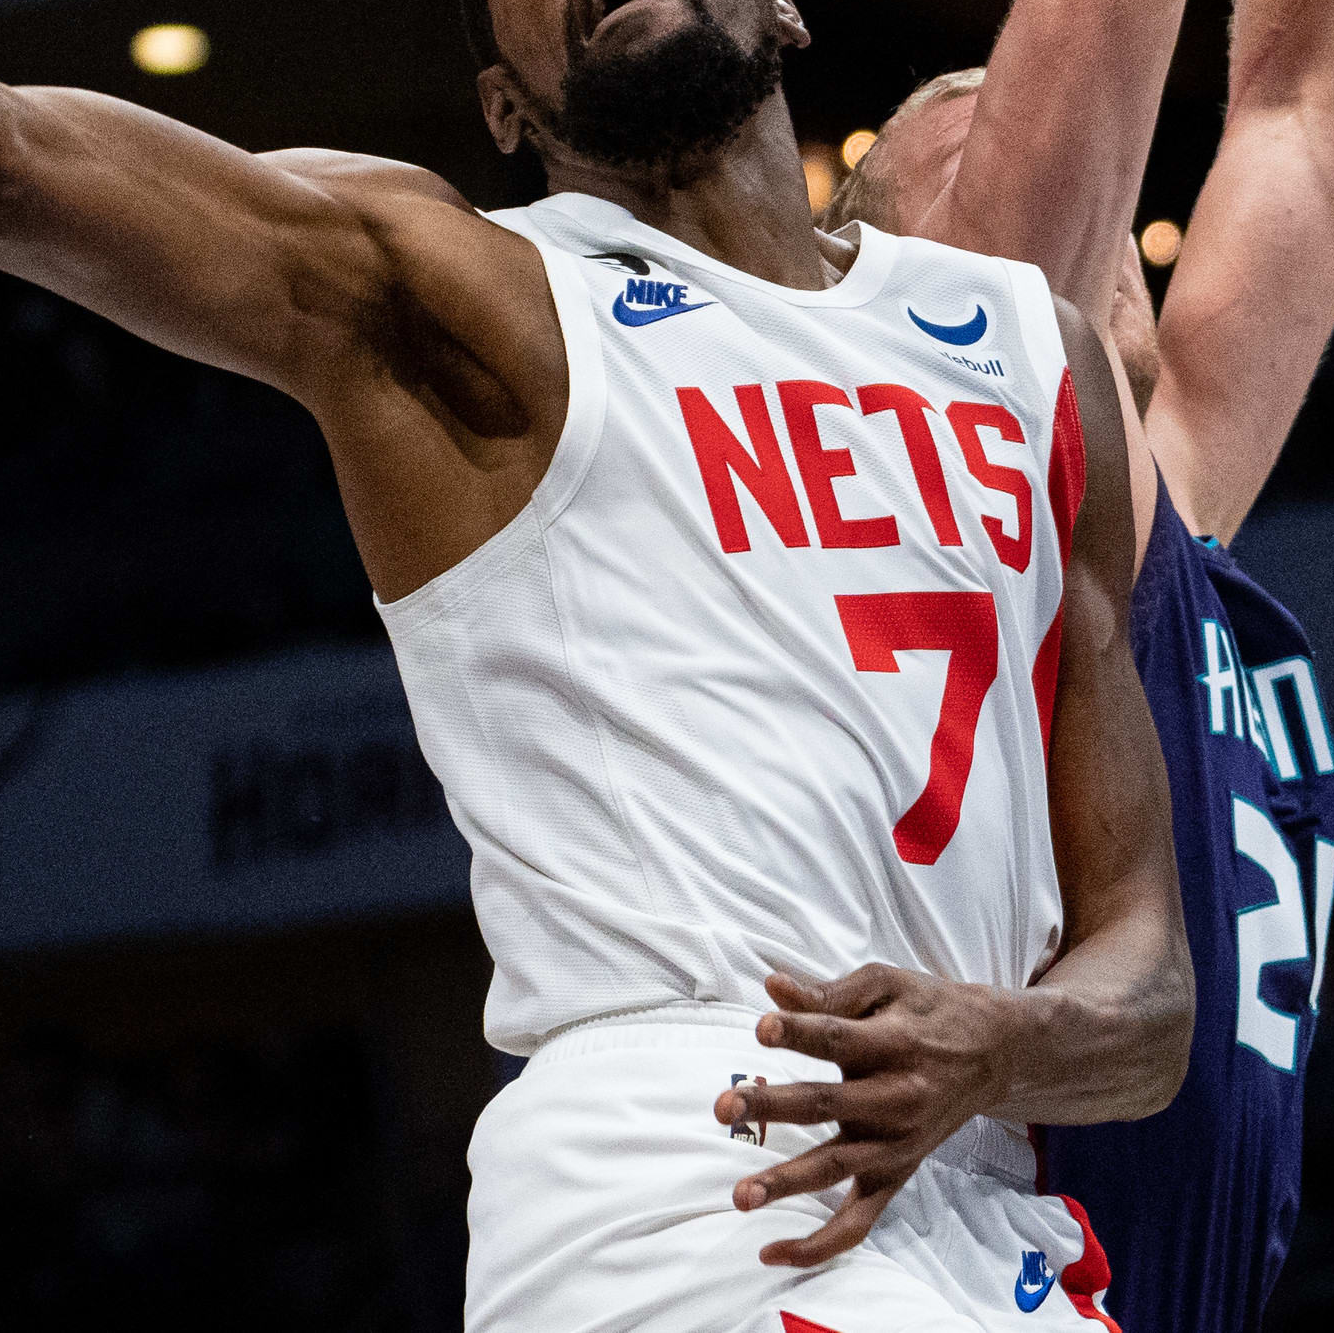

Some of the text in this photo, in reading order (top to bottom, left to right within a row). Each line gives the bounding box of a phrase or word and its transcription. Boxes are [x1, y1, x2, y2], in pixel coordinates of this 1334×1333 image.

[625, 277, 689, 307] NIKE
[676, 378, 1033, 575] NETS
[834, 591, 999, 866] 7
